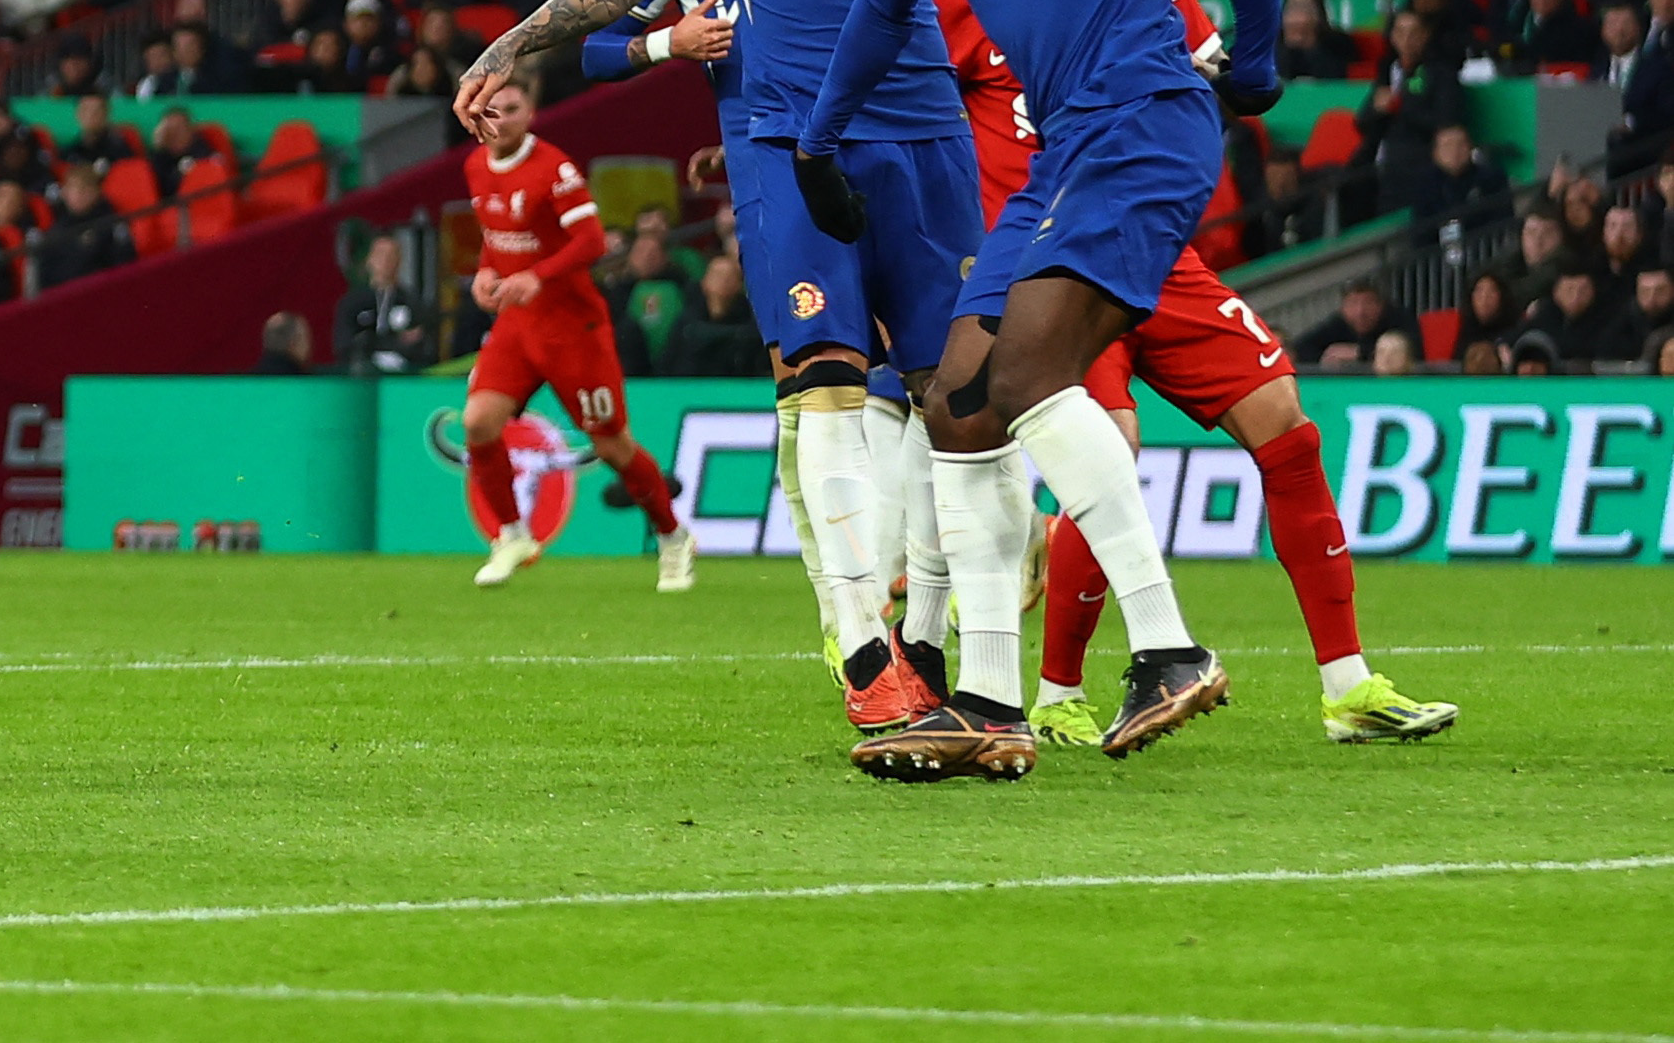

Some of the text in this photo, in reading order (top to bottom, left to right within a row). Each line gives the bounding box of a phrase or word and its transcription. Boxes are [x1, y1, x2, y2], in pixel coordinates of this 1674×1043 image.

[1217, 297, 1272, 344] 7
[577, 386, 613, 420] 10
[1336, 403, 1674, 556] BEE
